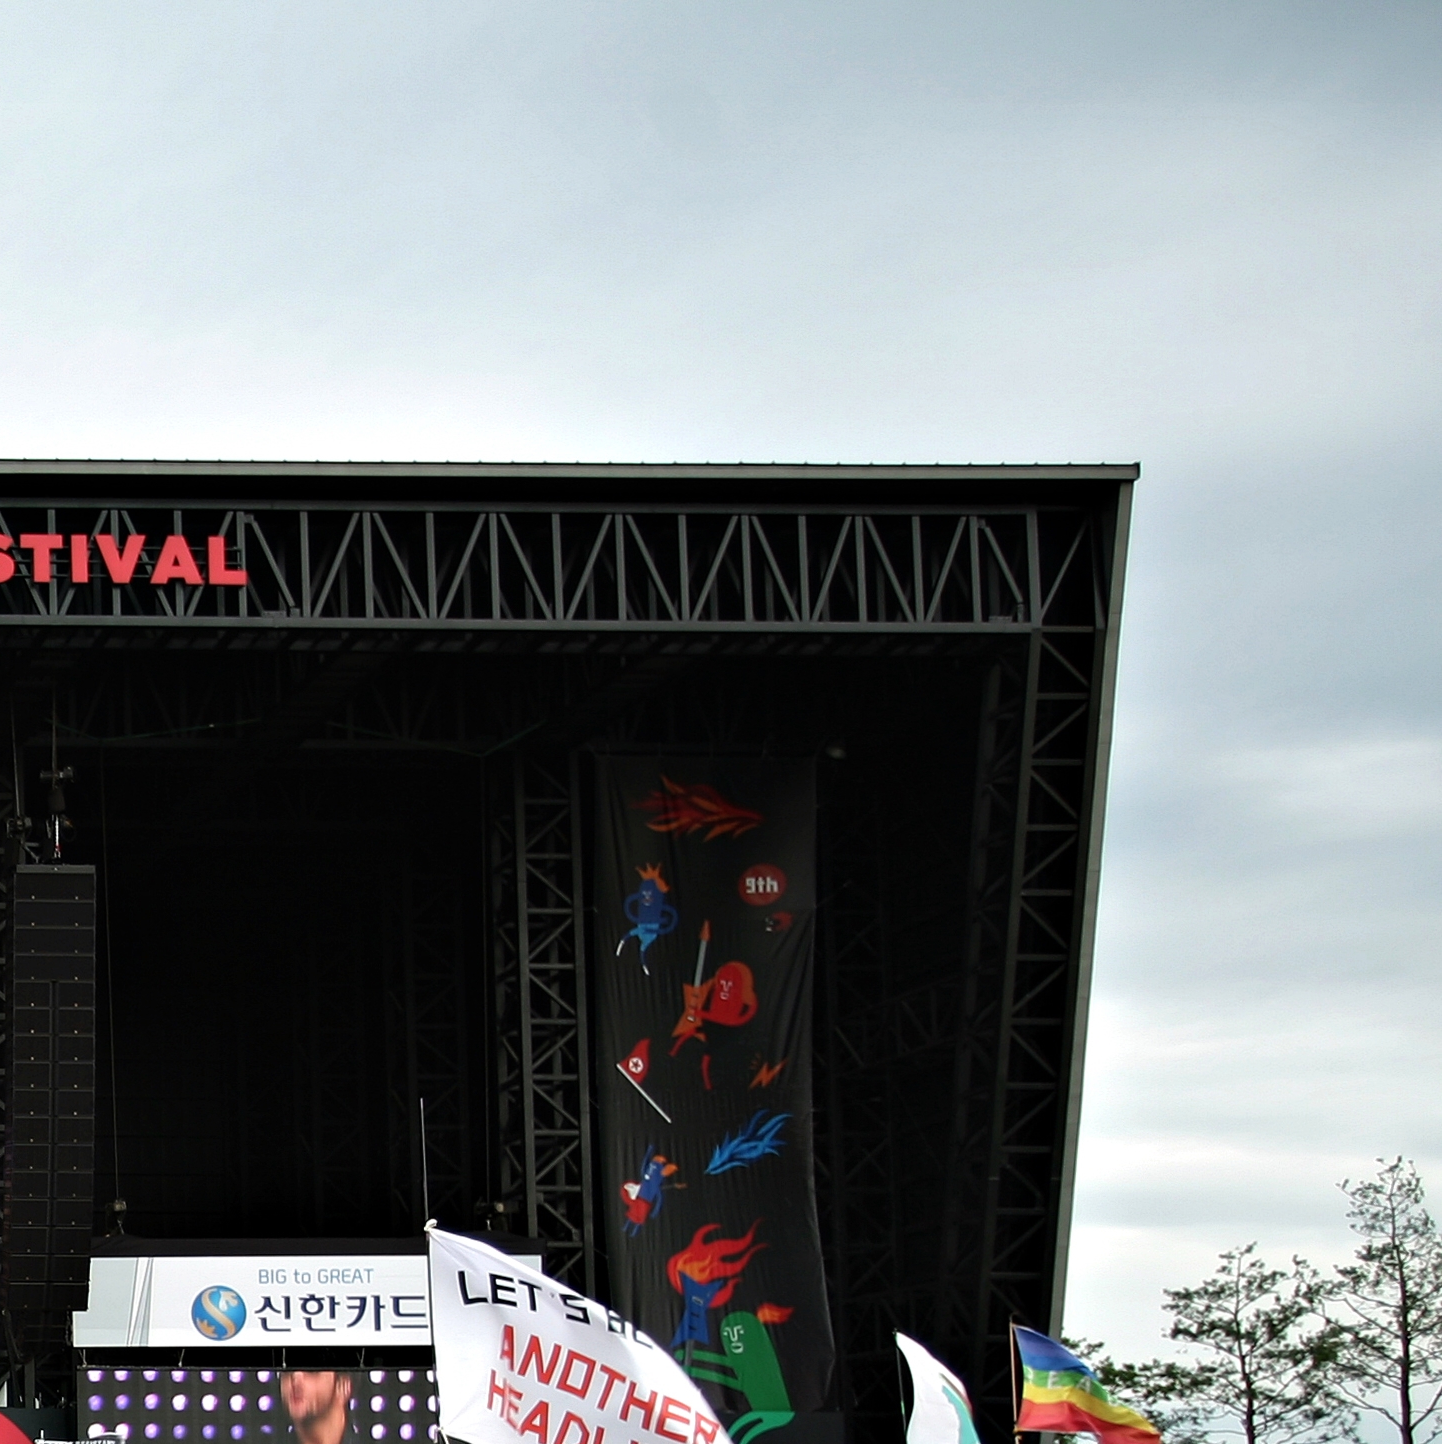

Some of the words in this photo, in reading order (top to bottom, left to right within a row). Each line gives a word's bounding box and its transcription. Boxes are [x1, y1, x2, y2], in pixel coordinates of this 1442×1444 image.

[745, 876, 779, 895] 9th
[258, 1269, 287, 1284] BIG
[293, 1269, 311, 1284] to
[317, 1269, 375, 1284] GREAT
[458, 1269, 592, 1325] LET'S
[254, 1293, 429, 1333] 신한카드
